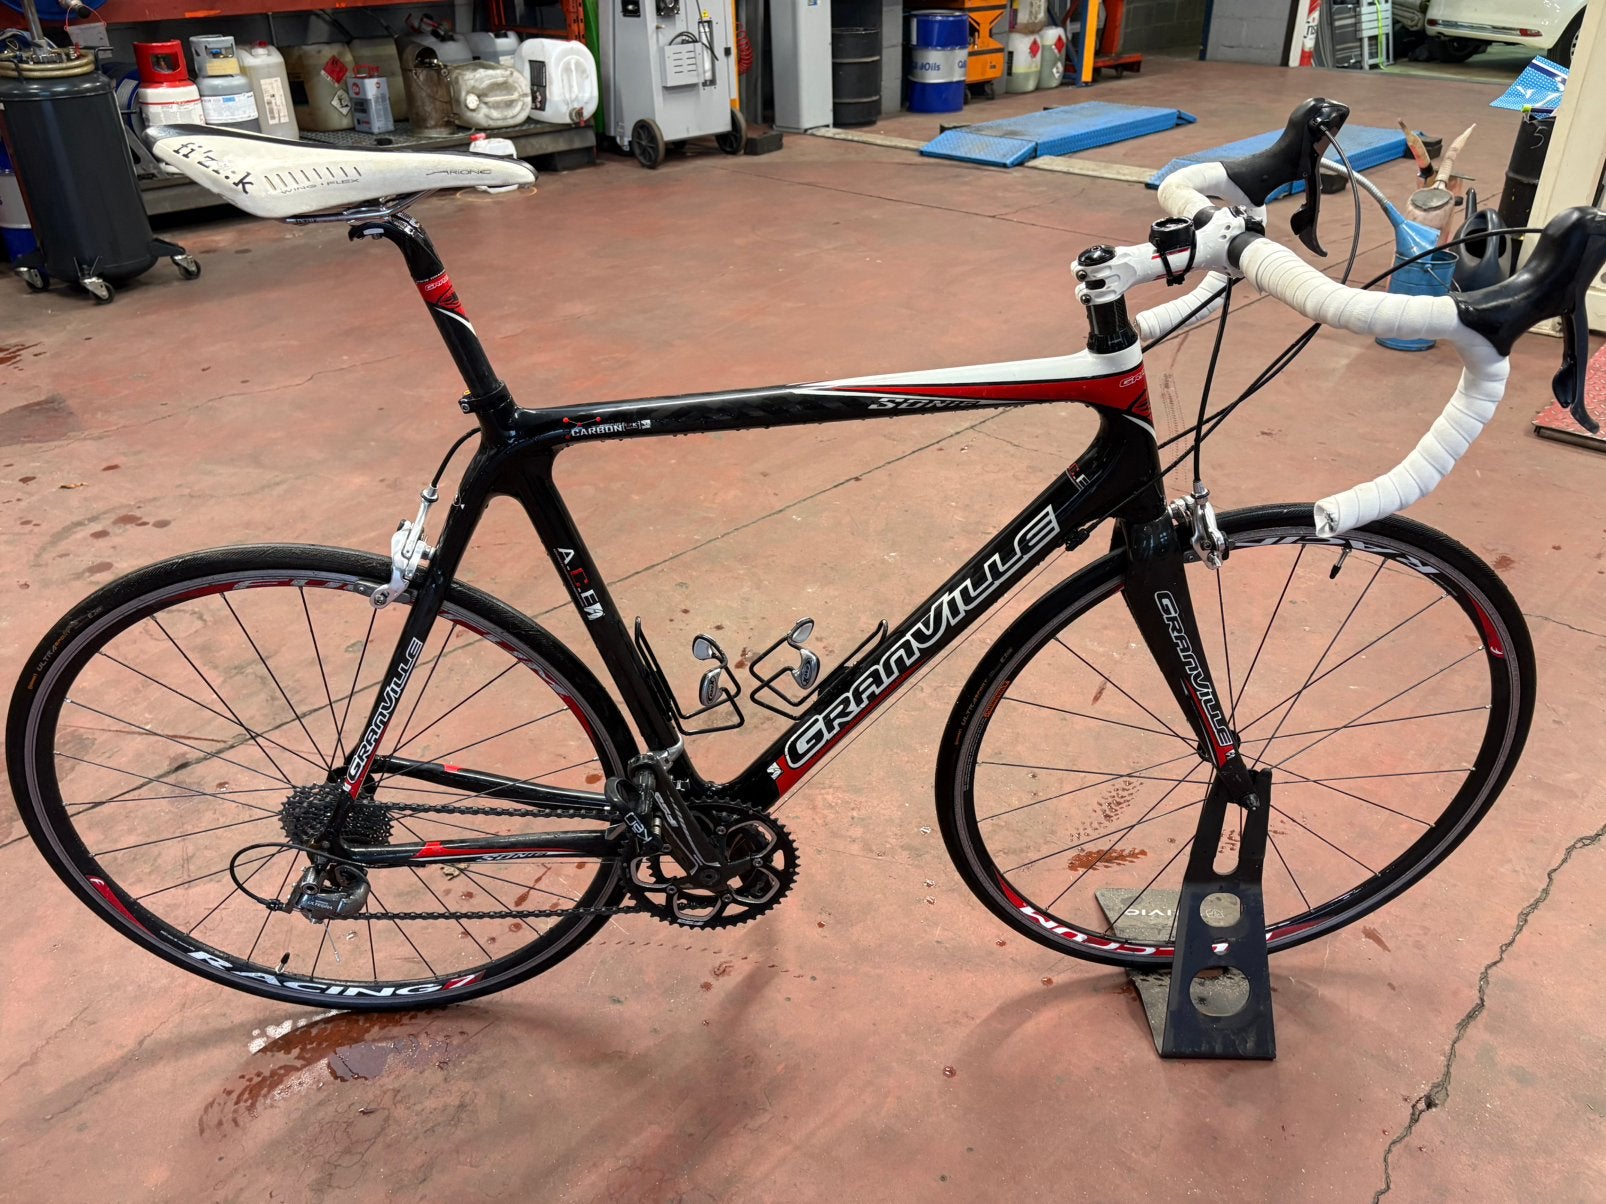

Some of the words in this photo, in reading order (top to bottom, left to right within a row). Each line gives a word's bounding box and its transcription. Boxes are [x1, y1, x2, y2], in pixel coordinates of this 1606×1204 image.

[571, 422, 624, 437] CARBON
[346, 636, 424, 784] GRANVILLE
[785, 504, 1061, 769] GRANVILLE
[1154, 590, 1234, 747] GRANVILLE
[186, 951, 442, 998] RACING
